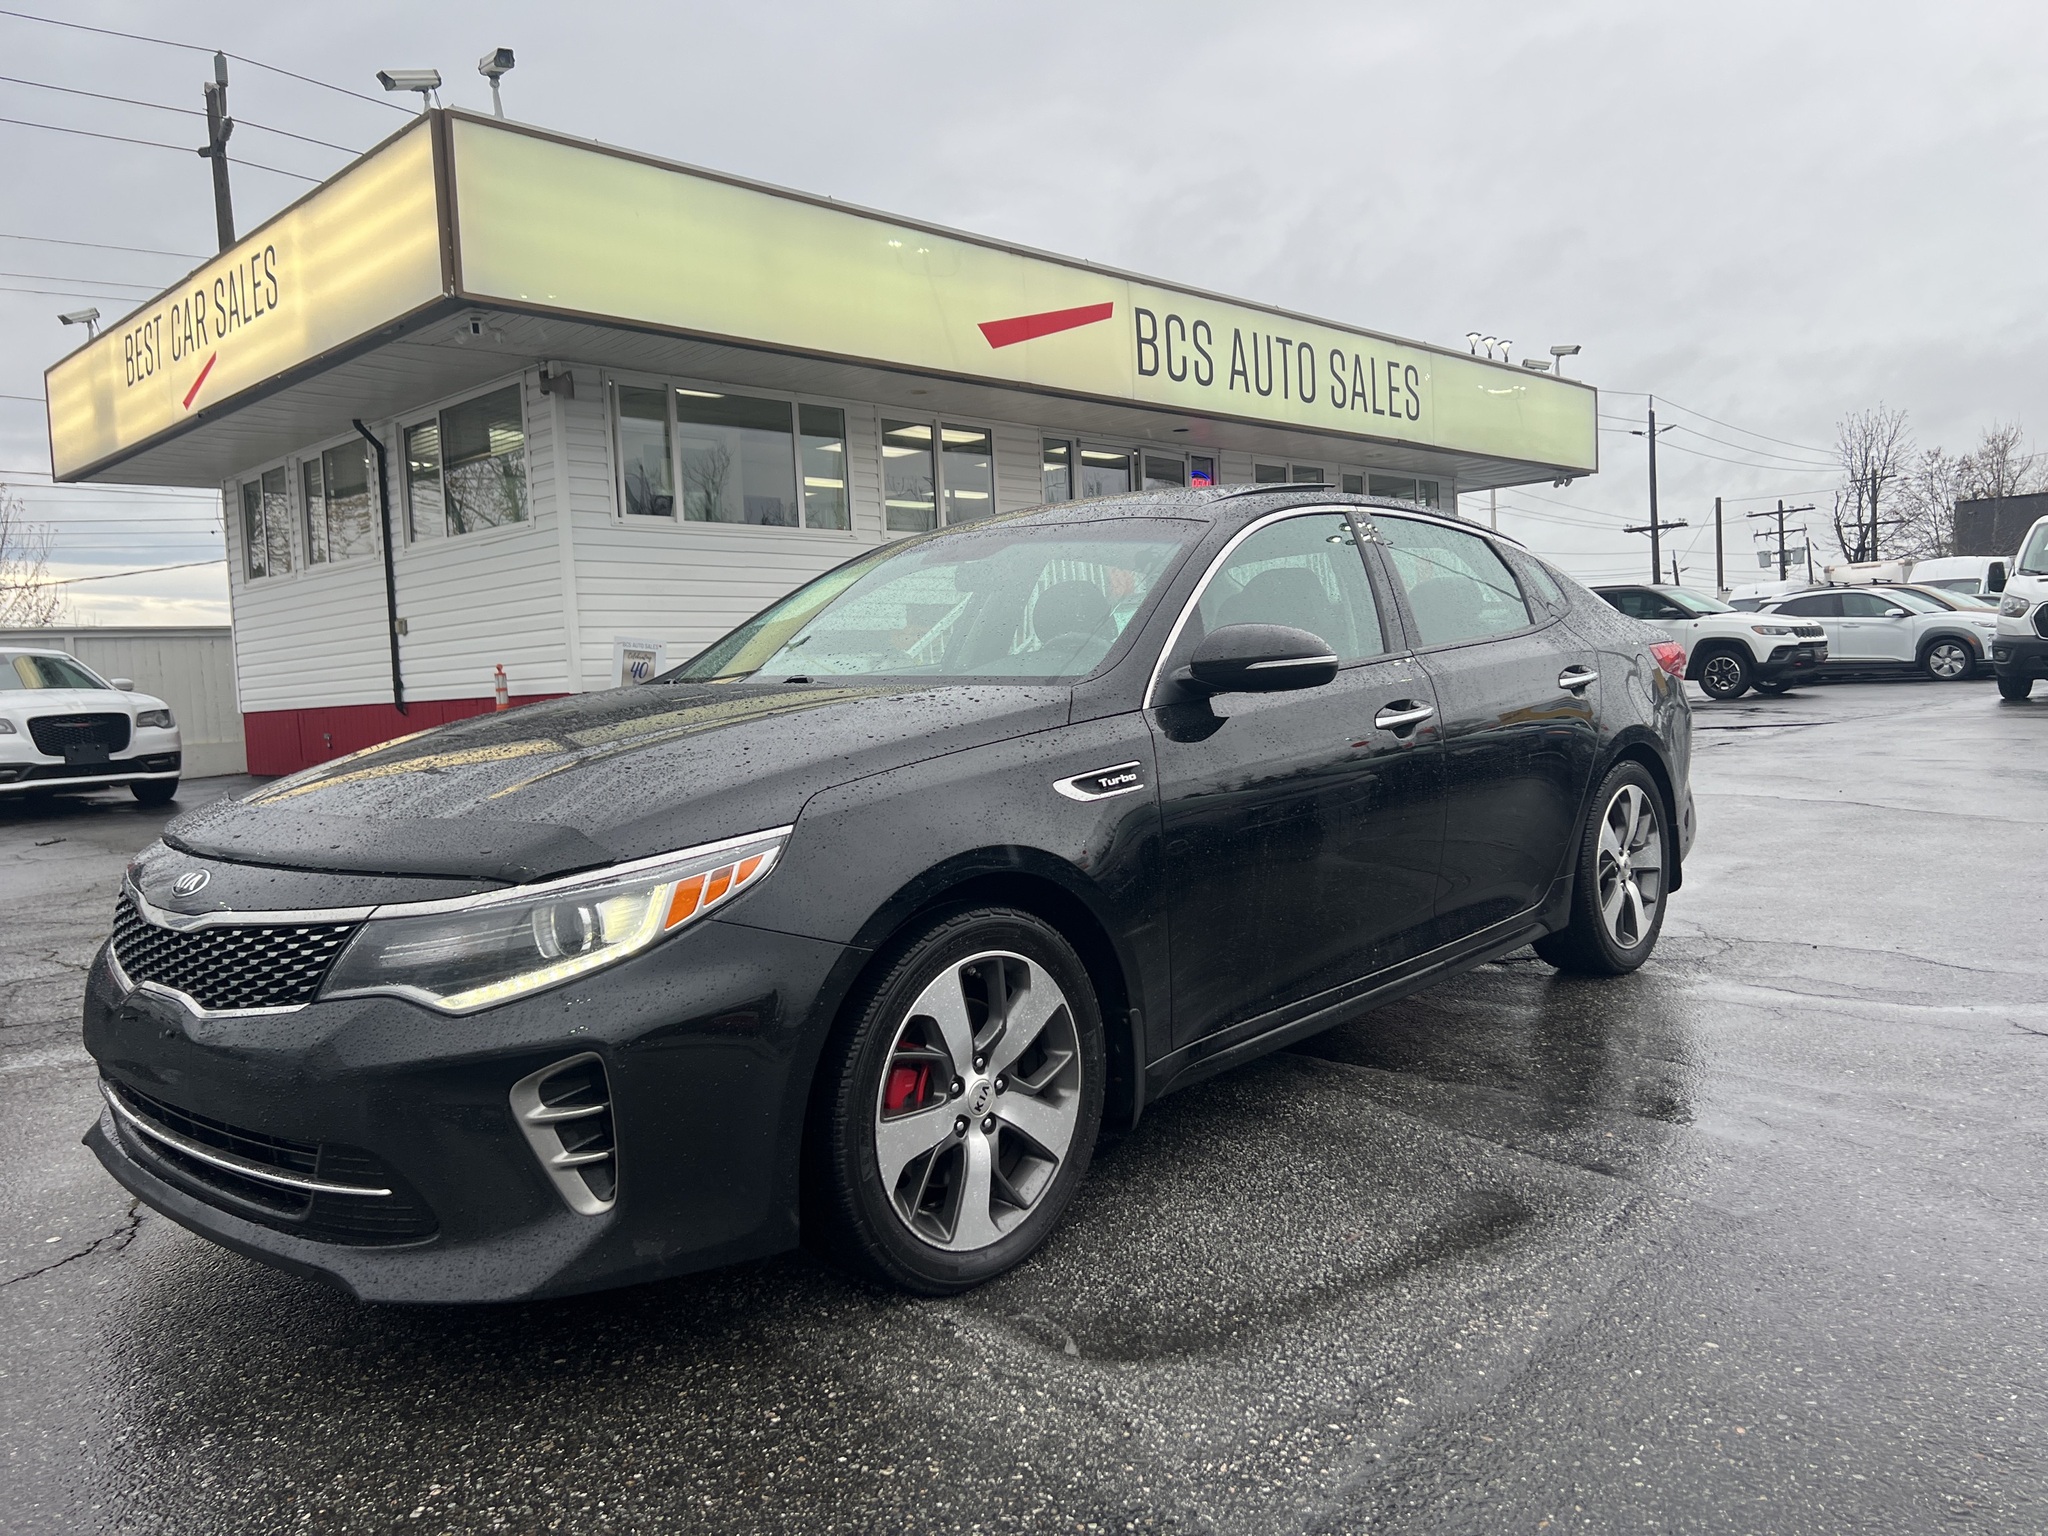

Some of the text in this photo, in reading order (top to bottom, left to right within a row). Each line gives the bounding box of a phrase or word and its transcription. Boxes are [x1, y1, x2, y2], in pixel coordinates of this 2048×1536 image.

[125, 245, 278, 387] BEST CAR SALES
[1134, 307, 1420, 421] BCS AUTO SALES
[1191, 478, 1210, 488] PEN
[630, 661, 649, 679] 40
[1098, 773, 1137, 787] Turbo
[174, 872, 203, 891] KIA
[974, 1086, 990, 1112] KIA
